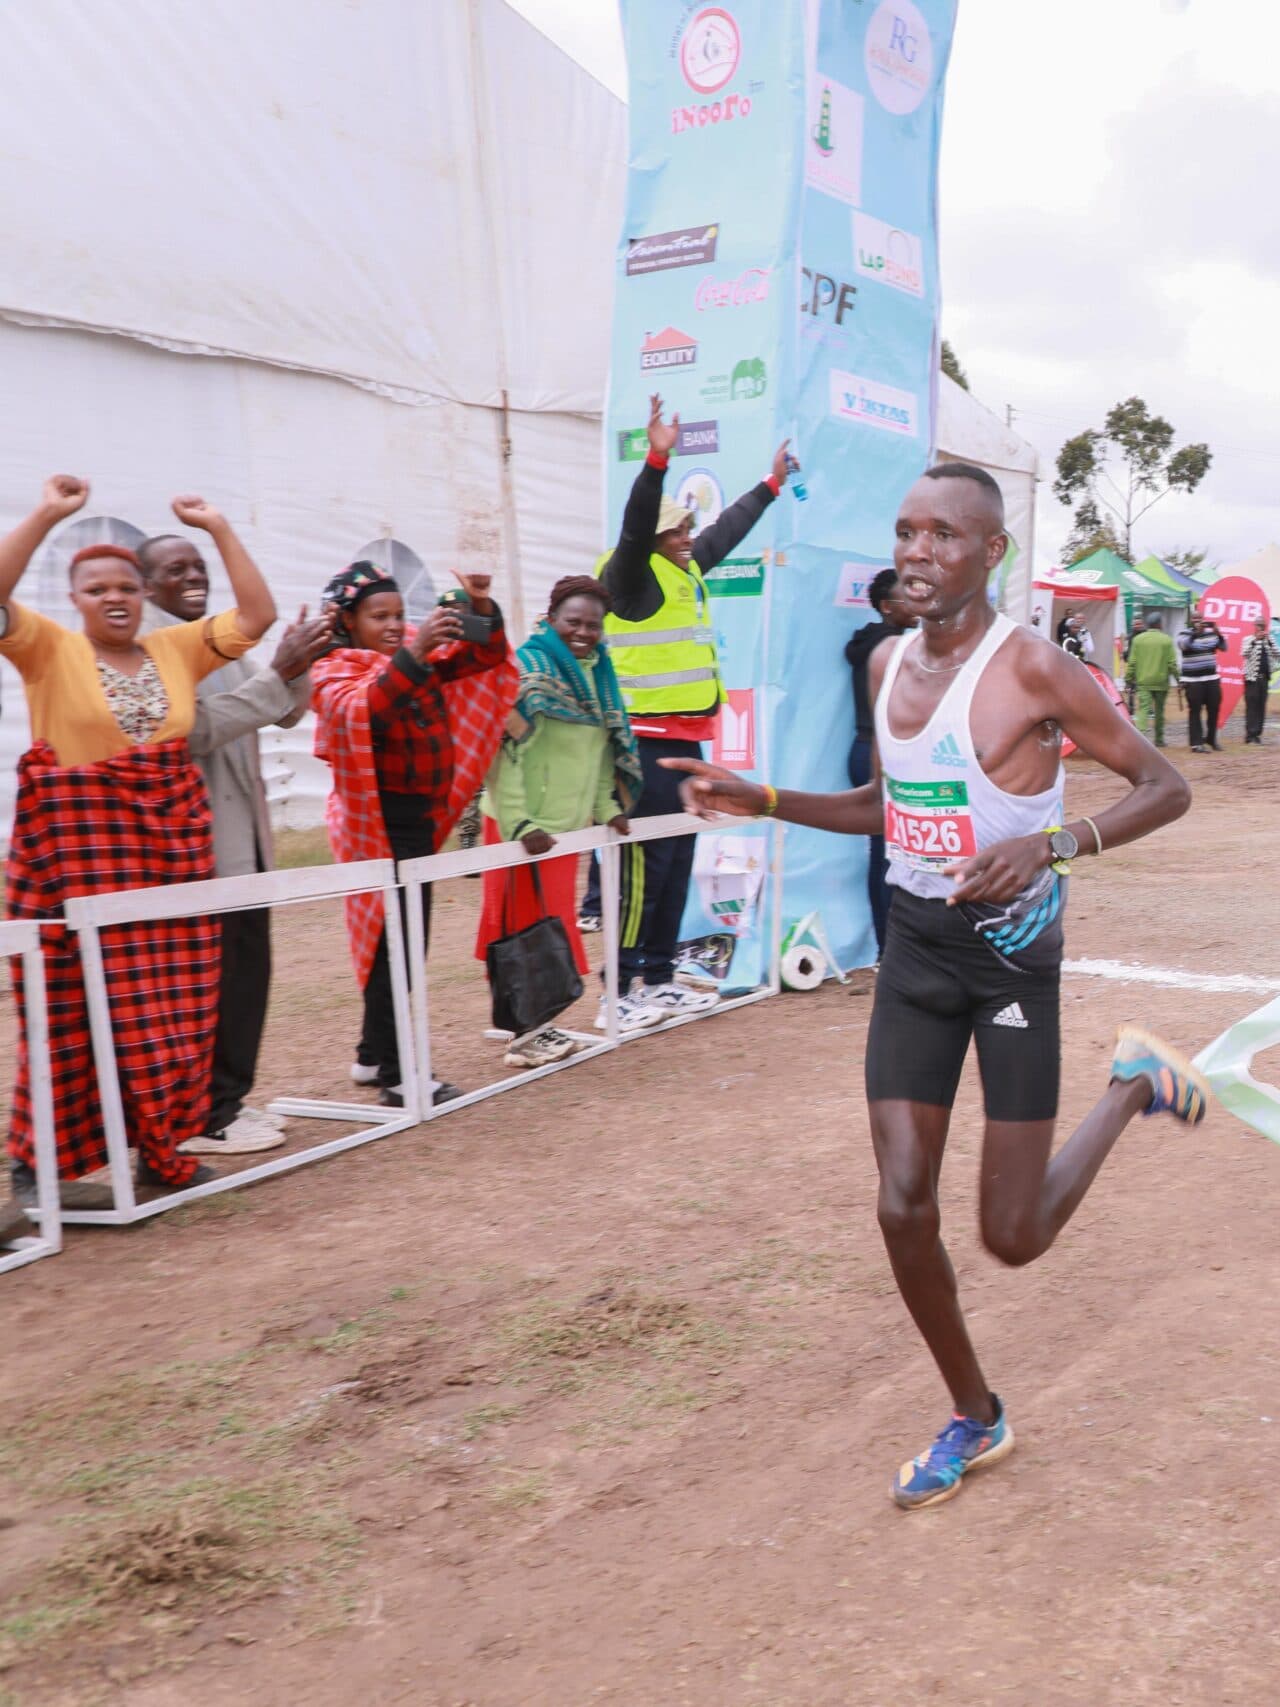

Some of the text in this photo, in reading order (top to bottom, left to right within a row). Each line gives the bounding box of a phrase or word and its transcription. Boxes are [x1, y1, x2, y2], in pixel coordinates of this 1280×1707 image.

[642, 348, 695, 368] EQUITY
[683, 429, 717, 447] BANK
[1203, 597, 1263, 622] DTB
[992, 1016, 1029, 1028] adidas
